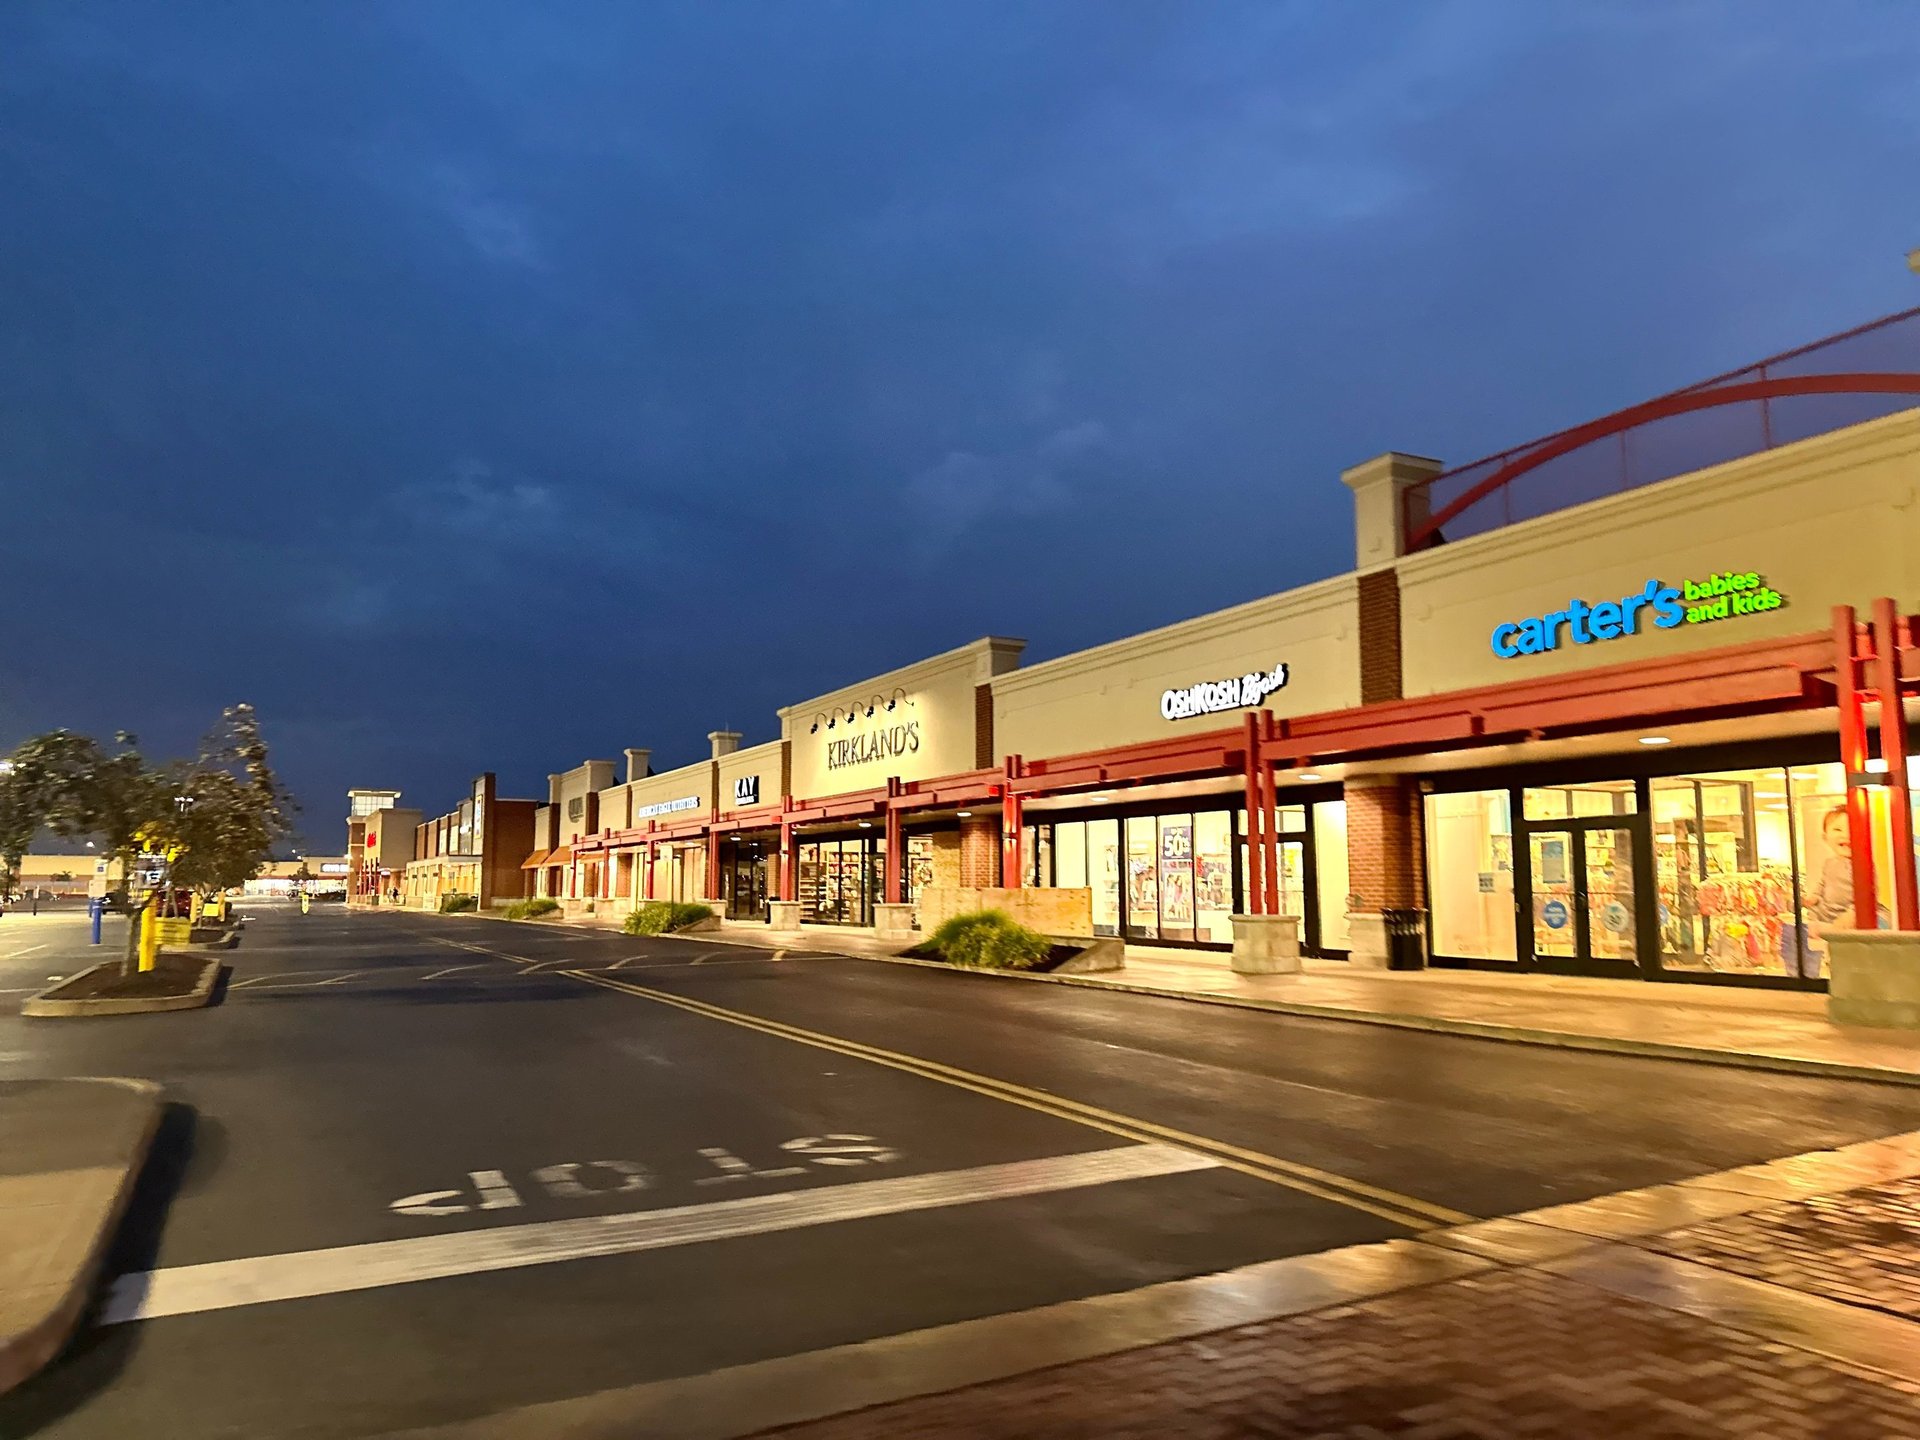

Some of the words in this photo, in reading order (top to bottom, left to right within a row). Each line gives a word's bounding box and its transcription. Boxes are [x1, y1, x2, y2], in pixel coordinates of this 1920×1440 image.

[1684, 572, 1760, 600] babies
[1686, 596, 1728, 623] and
[1732, 588, 1781, 614] kids
[1491, 579, 1683, 658] carter's
[828, 721, 919, 770] KIRKLAND'S
[734, 775, 755, 798] KAY
[389, 1133, 902, 1216] STOP
